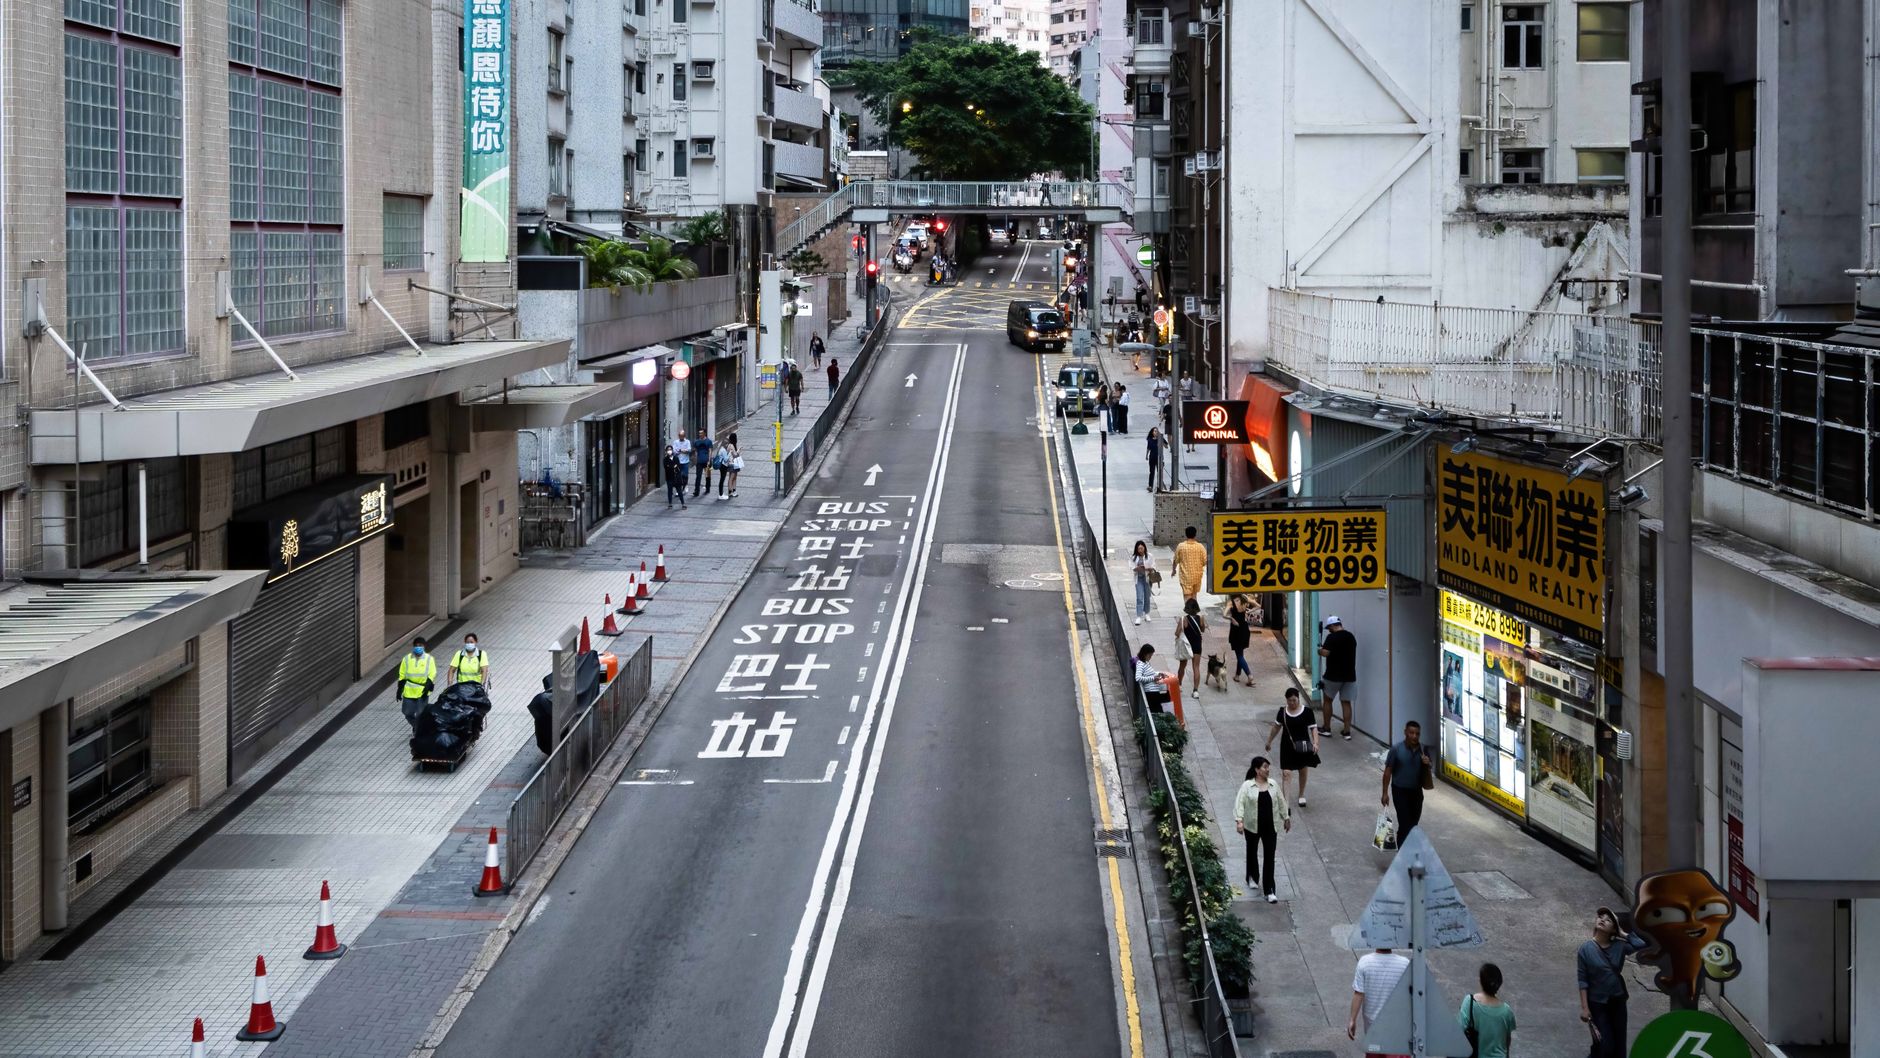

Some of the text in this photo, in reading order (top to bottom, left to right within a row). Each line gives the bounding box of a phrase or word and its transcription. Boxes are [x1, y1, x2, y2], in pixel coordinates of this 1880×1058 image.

[1194, 430, 1239, 439] NOMINAL
[816, 502, 889, 515] BUS
[1443, 457, 1599, 583] 美聯物業
[800, 519, 892, 532] STOP
[1221, 517, 1377, 557] 美聯物業
[793, 536, 874, 561] 巴士
[787, 564, 852, 591] 站
[1221, 555, 1378, 588] 2526 8999
[1443, 541, 1519, 585] MIDLAND
[1529, 572, 1599, 615] REALTY
[760, 598, 854, 616] BUS
[732, 623, 855, 644] STOP
[1474, 604, 1496, 632] 2526
[1499, 614, 1523, 642] 8999
[715, 653, 831, 693] 巴士
[697, 711, 797, 759] 站
